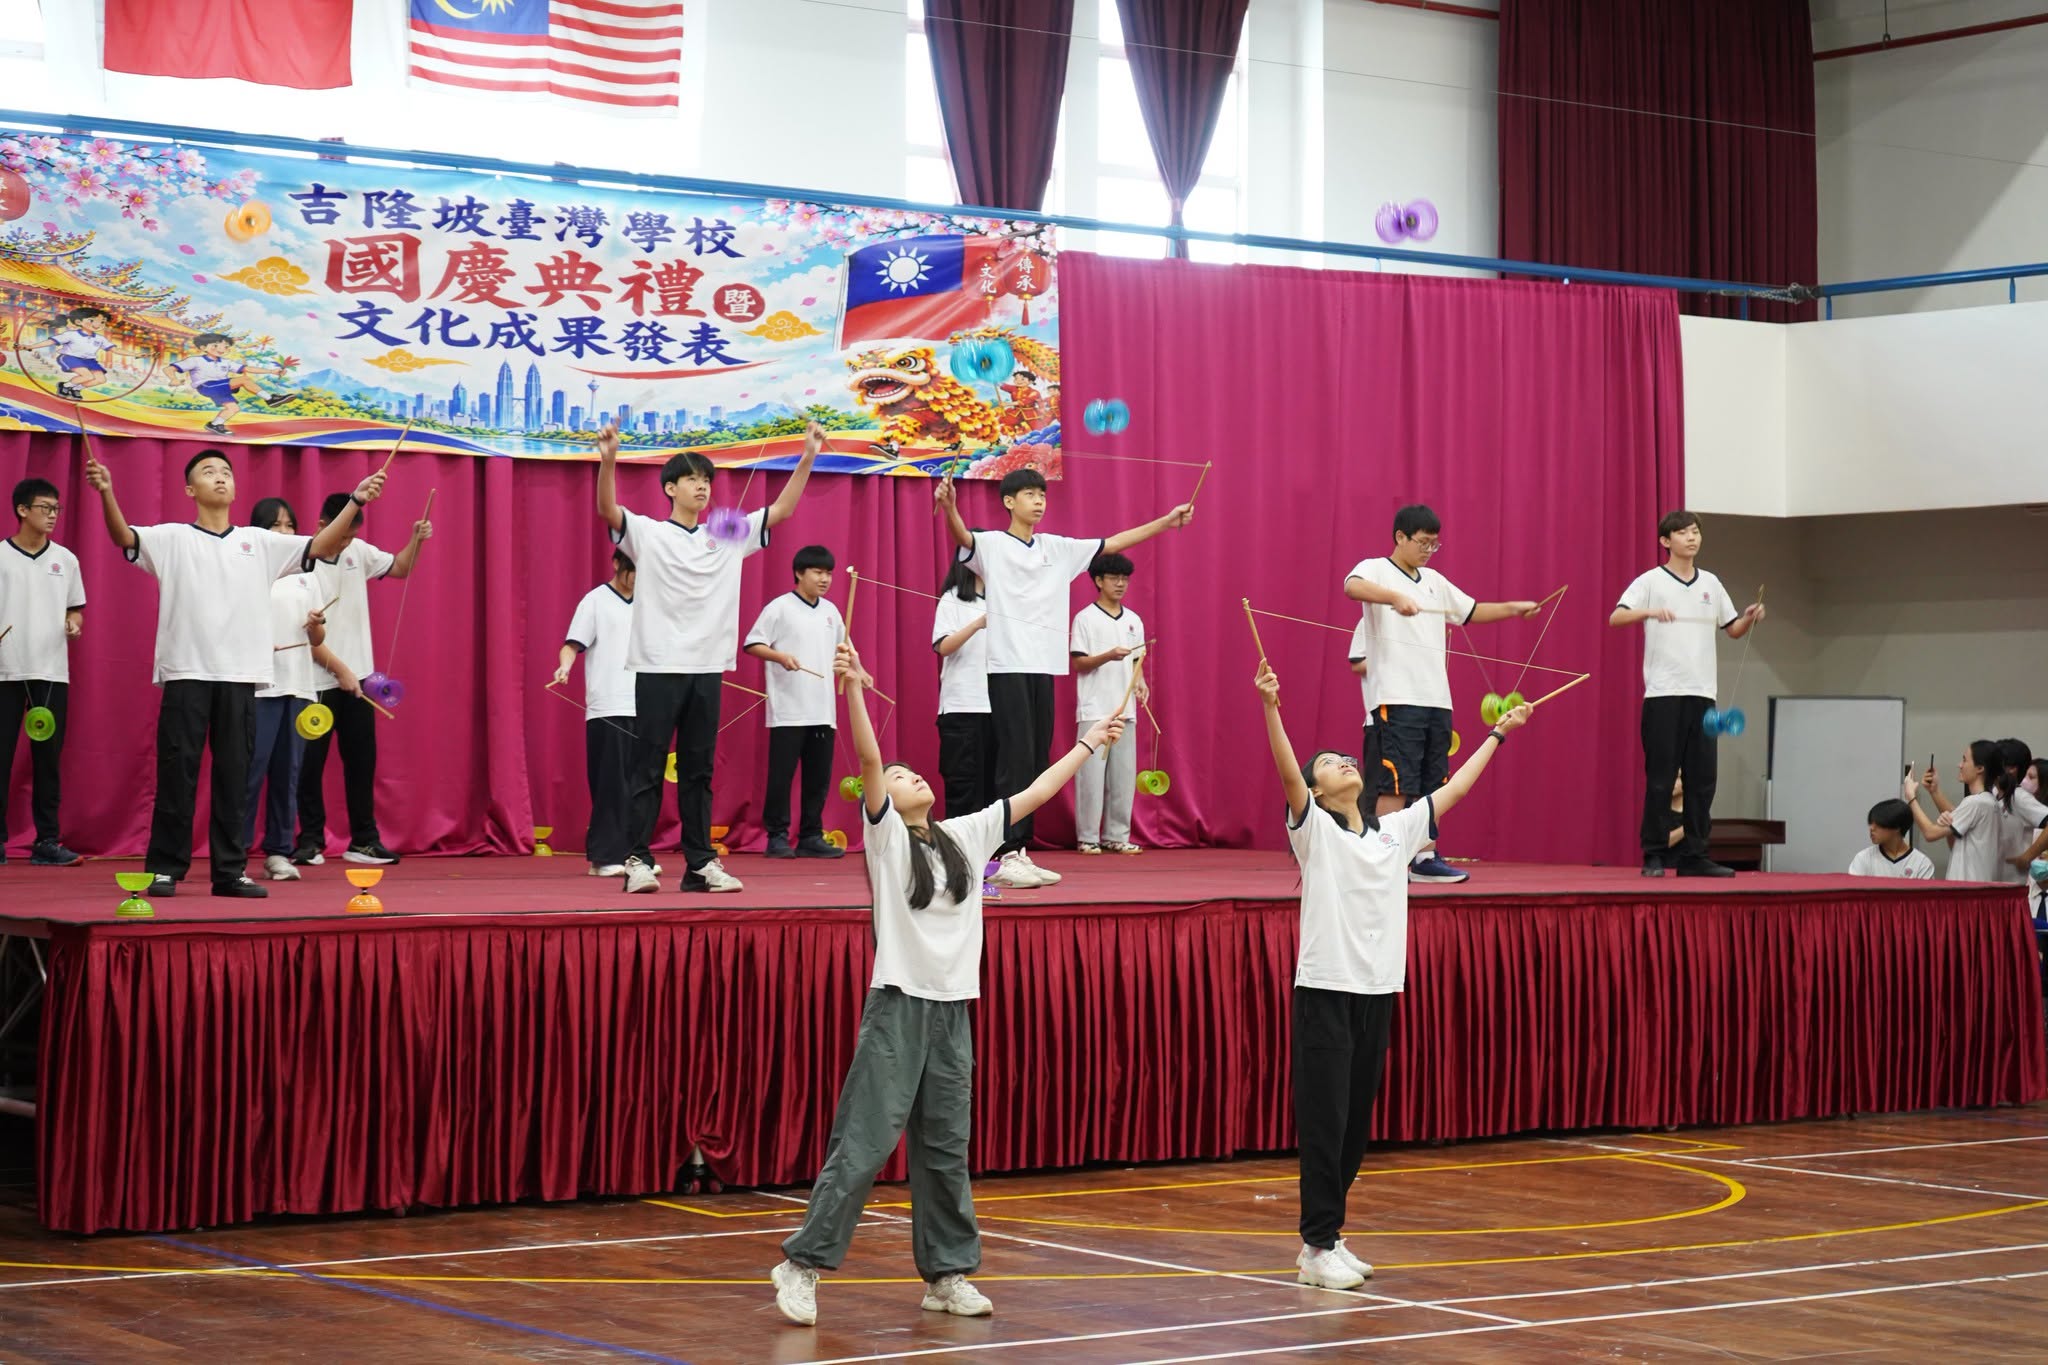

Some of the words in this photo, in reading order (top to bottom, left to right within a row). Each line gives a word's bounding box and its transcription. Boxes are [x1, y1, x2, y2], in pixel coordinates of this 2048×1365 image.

[287, 182, 747, 258] 吉隆坡臺灣學校
[324, 231, 707, 318] 國慶典禮
[722, 287, 759, 319] 暨
[979, 263, 997, 294] 文化
[1016, 255, 1036, 292] 傳承
[335, 300, 752, 366] 文化成果發表
